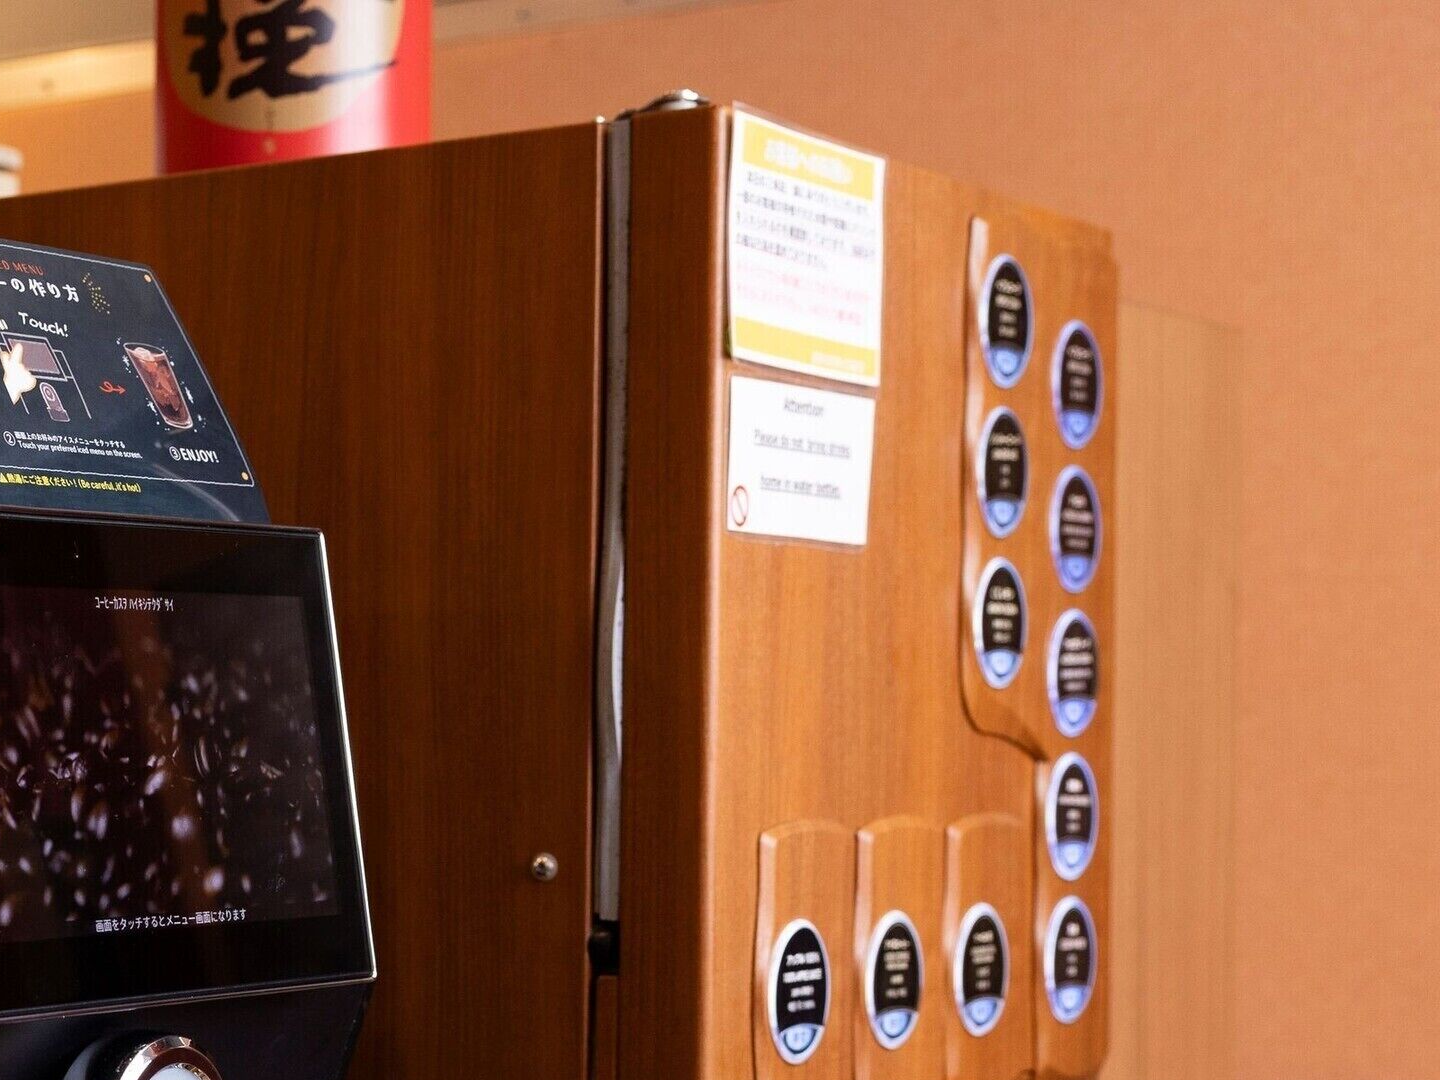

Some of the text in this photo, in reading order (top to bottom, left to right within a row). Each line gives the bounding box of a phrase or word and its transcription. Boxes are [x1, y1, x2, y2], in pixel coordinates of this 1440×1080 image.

[12, 262, 45, 276] MENU
[18, 311, 69, 337] Touch!
[17, 440, 37, 449] Touch
[36, 443, 49, 451] your
[51, 443, 77, 453] preferred
[77, 446, 89, 454] iced
[113, 449, 123, 457] the
[180, 447, 220, 463] ENJOY!
[95, 908, 247, 933] 画面をタッチするとメニュー画面になります
